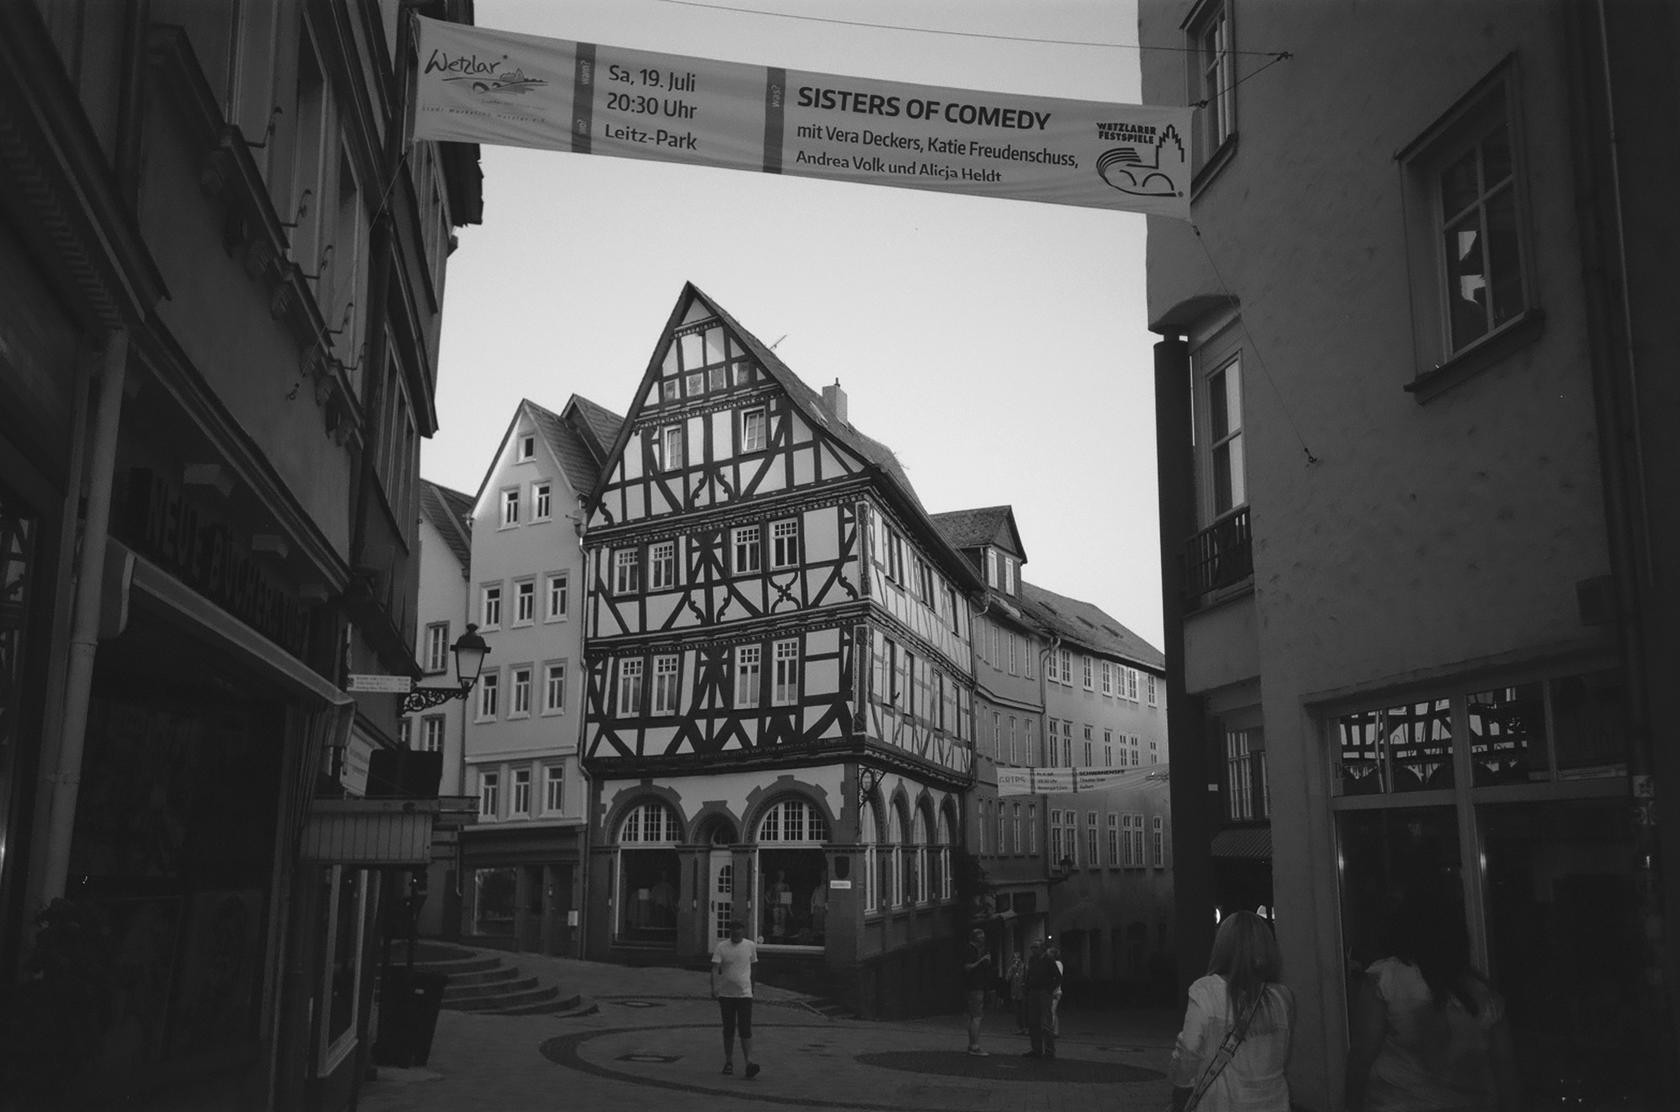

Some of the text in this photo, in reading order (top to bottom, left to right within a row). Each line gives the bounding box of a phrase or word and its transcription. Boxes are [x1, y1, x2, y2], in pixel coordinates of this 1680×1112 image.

[424, 49, 501, 75] Wetzlar
[608, 64, 696, 92] Sa, 19. Juli
[607, 91, 698, 119] 20:30 Uhr
[797, 86, 1052, 131] SISTERS OF COMEDY
[605, 123, 697, 150] Leitz-Park
[1096, 122, 1157, 136] WETZLARER
[1098, 130, 1154, 145] FESTSPIELE
[797, 124, 1079, 169] mit Vera Deckers, Katie Freudenschuss,
[796, 150, 1002, 183] Andrea Volk und Alicja Heldt
